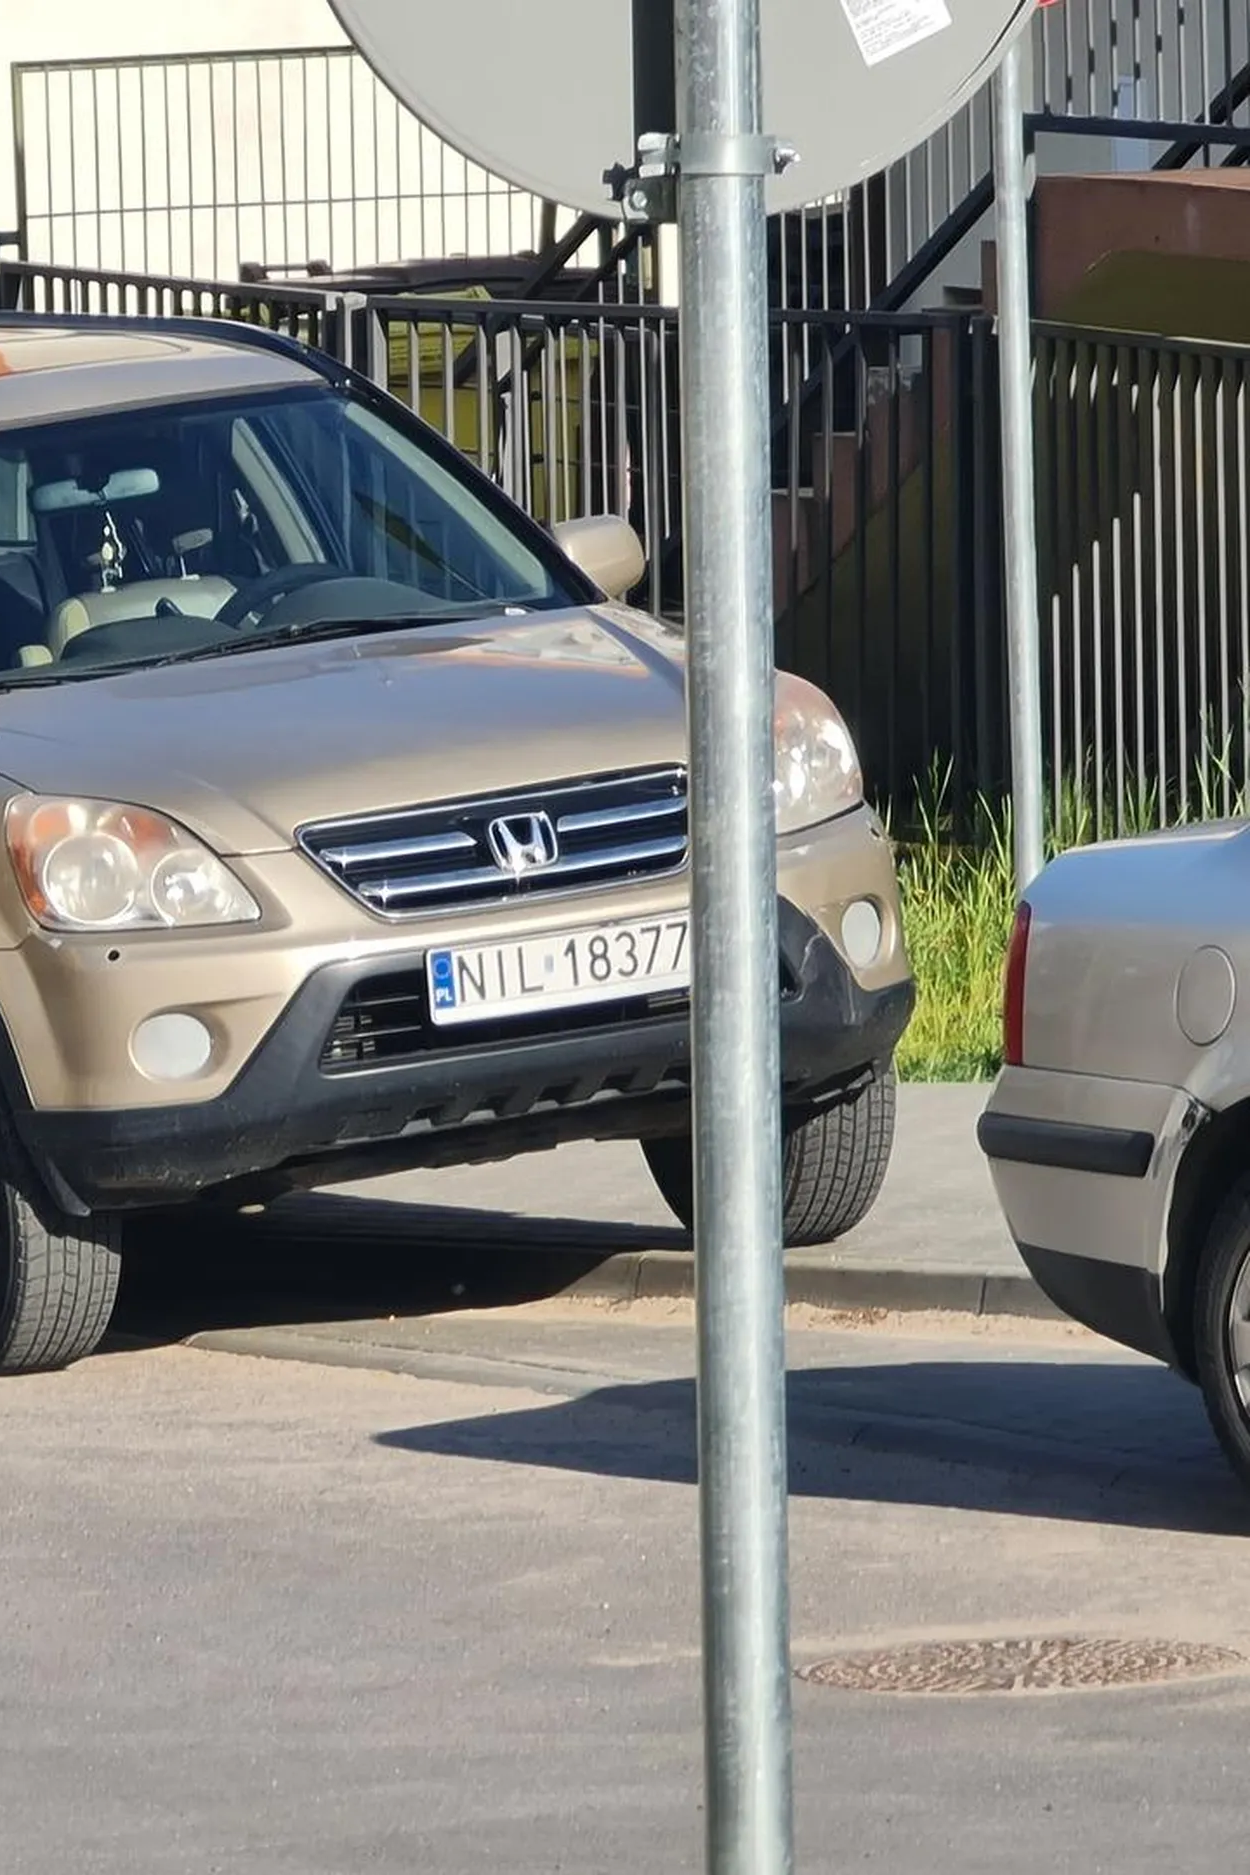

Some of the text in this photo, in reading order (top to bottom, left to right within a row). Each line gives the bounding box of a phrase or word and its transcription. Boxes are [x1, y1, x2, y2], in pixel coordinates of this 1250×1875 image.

[456, 921, 688, 1003] NIL 18377
[436, 987, 453, 1003] PL
